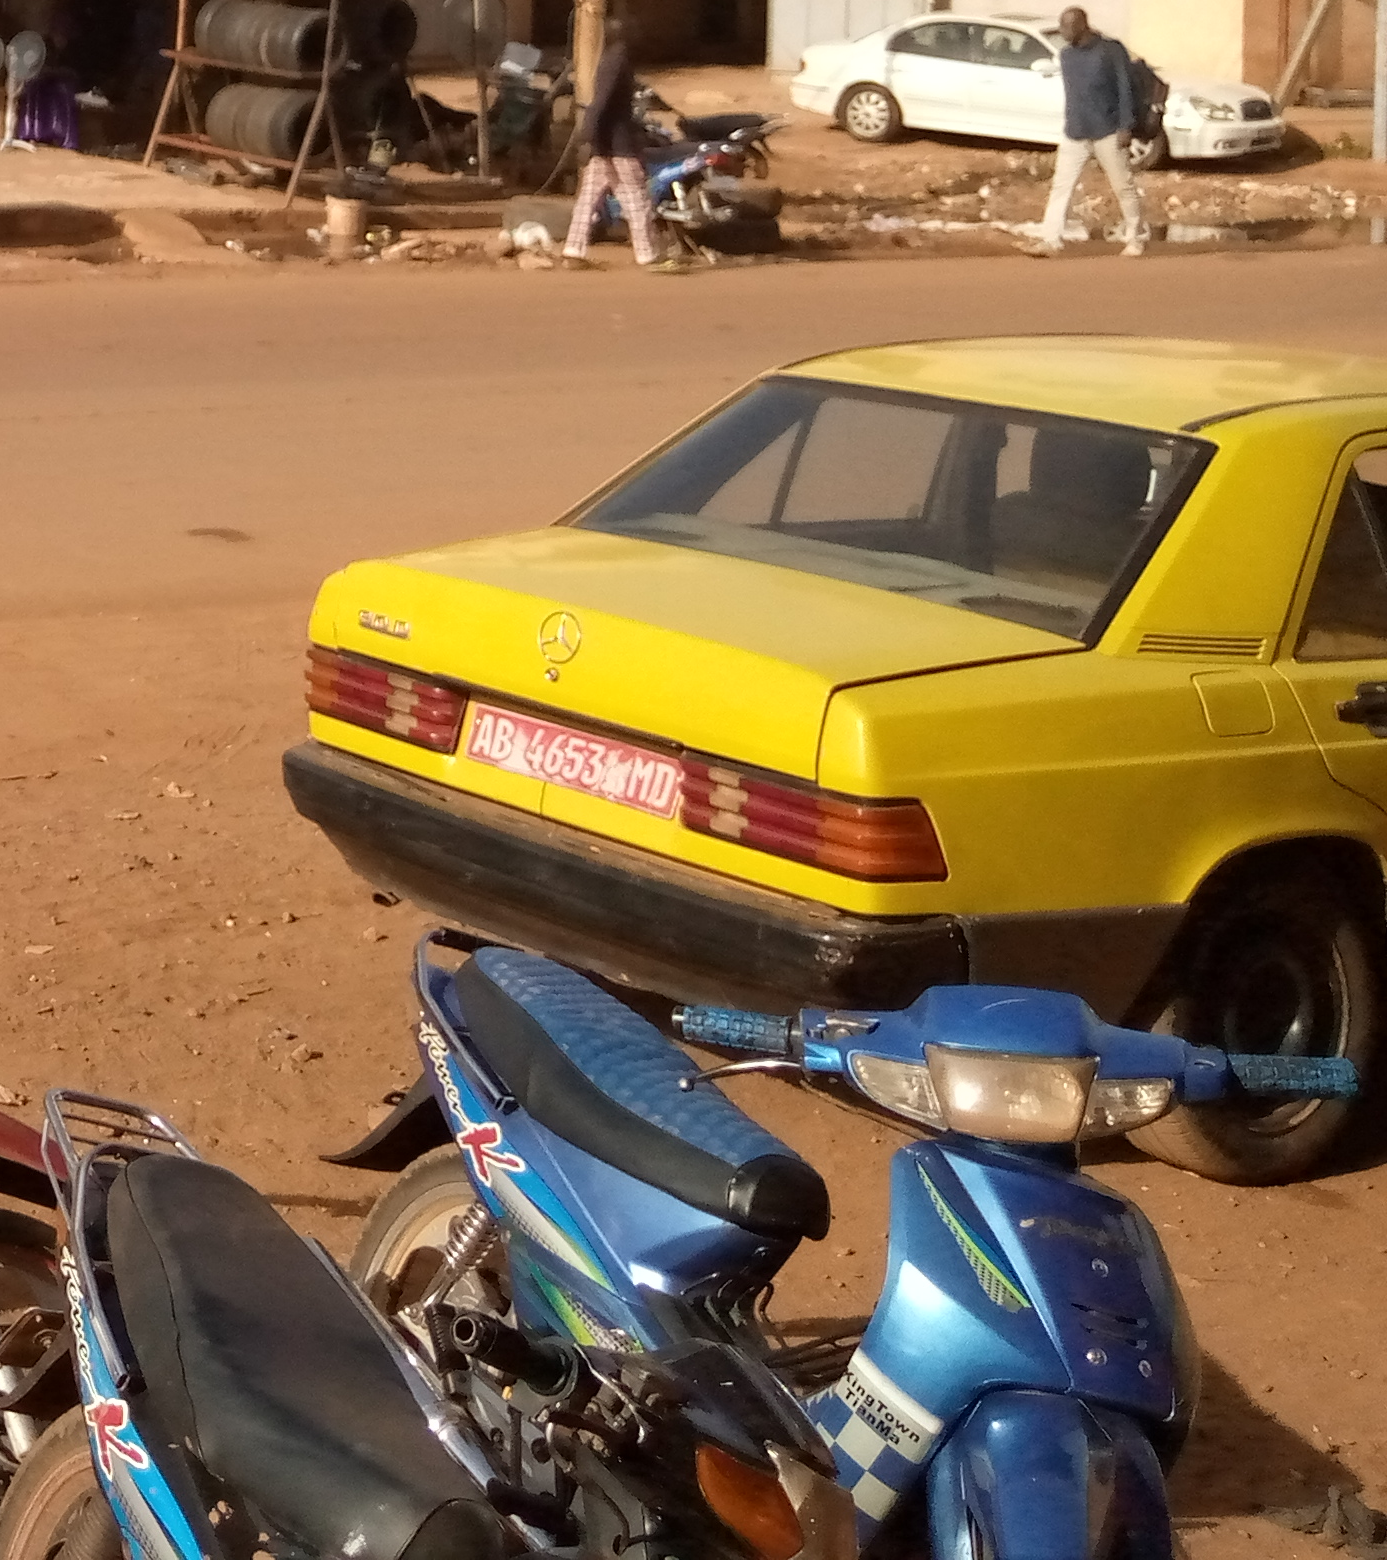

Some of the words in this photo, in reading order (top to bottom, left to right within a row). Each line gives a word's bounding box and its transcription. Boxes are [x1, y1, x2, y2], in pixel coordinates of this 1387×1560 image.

[471, 714, 516, 761] AB
[526, 728, 606, 787] 4653
[626, 753, 677, 808] MD
[845, 1387, 900, 1445] TianMa
